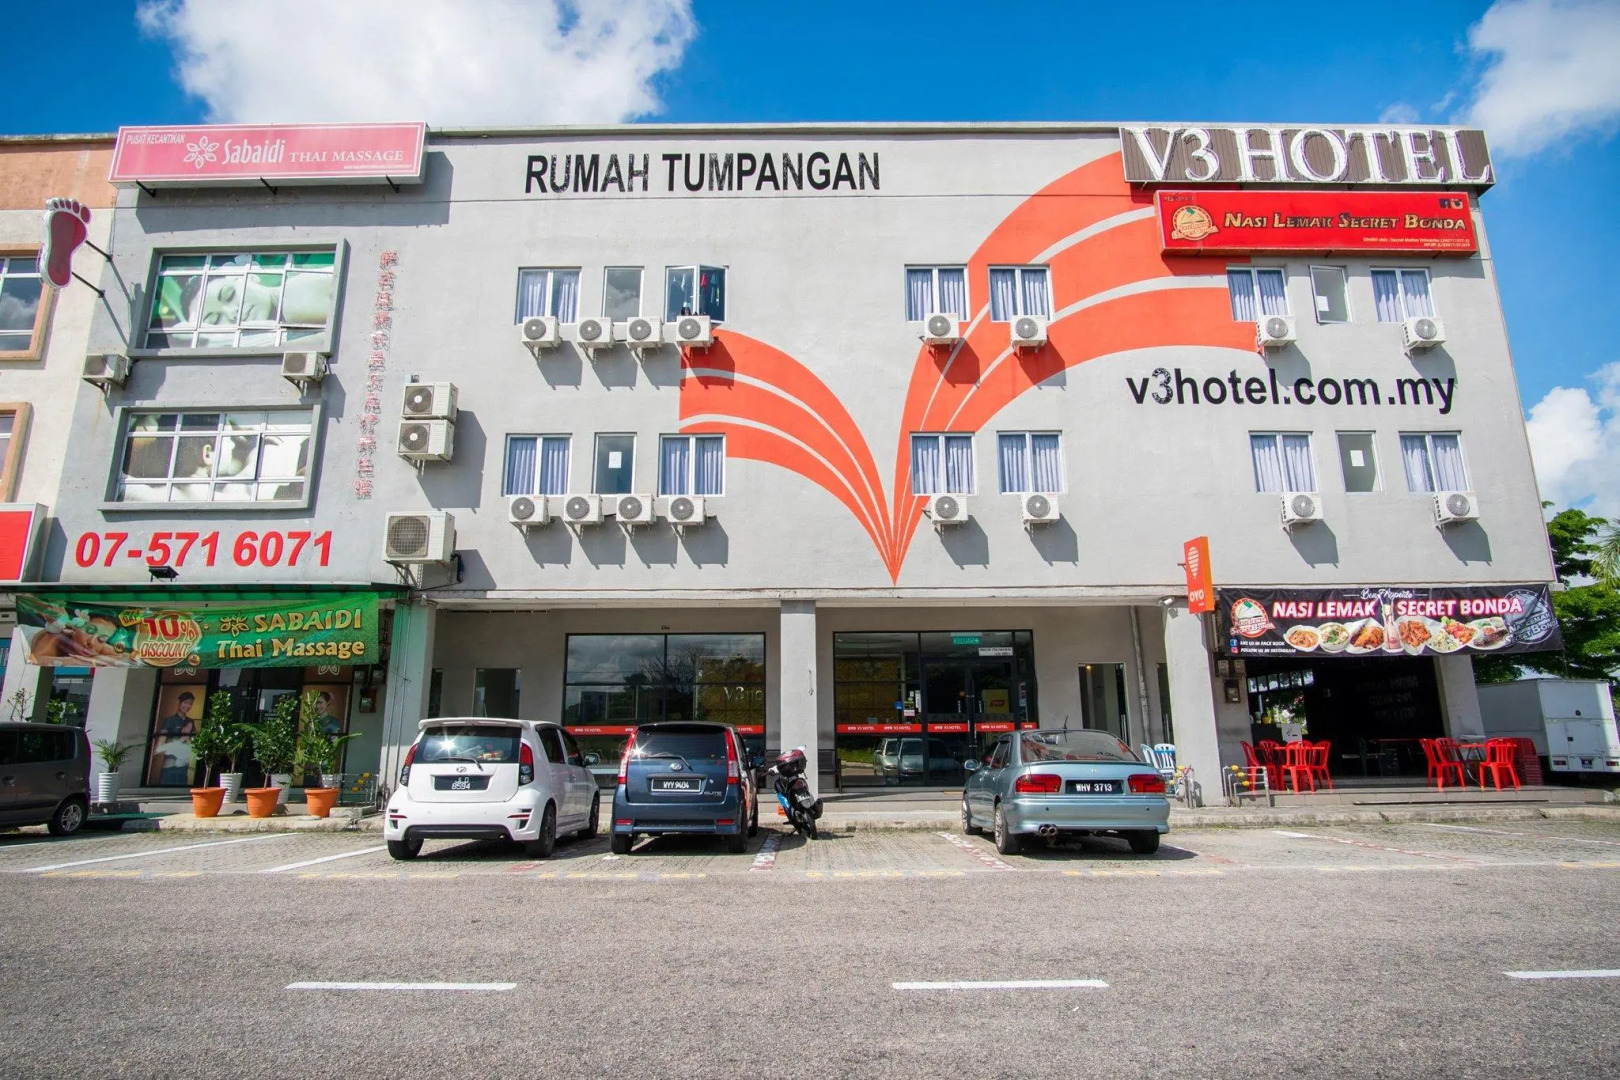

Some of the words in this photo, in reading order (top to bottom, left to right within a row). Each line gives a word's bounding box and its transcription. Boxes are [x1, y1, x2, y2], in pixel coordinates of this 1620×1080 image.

[222, 139, 286, 166] Sabaidi
[289, 151, 328, 163] THAI
[332, 149, 404, 163] MASSAGE
[1125, 128, 1220, 181] V3
[1234, 128, 1491, 181] HOTEL
[524, 153, 649, 193] RUMAH
[662, 151, 881, 192] TUMPANGAN
[1224, 212, 1267, 228] NASI
[1272, 212, 1332, 229] LEMAK
[1338, 213, 1399, 229] SECRET
[1405, 214, 1466, 230] BONDA
[1126, 367, 1455, 415] v3hotel.com.my
[75, 531, 220, 568] 07-571
[232, 530, 333, 568] 6071
[1190, 589, 1205, 602] OYO
[1272, 601, 1314, 618] NASI
[1317, 600, 1376, 618] LEMAK
[1396, 599, 1456, 617] SECRET
[1460, 597, 1524, 617] BONDA
[143, 616, 197, 641] 10%
[256, 609, 361, 632] SABAIDI
[140, 642, 192, 658] DISCOUNT
[217, 639, 264, 659] Thai
[271, 638, 366, 660] Massage
[1076, 783, 1090, 792] WHV
[1094, 783, 1112, 792] 3713
